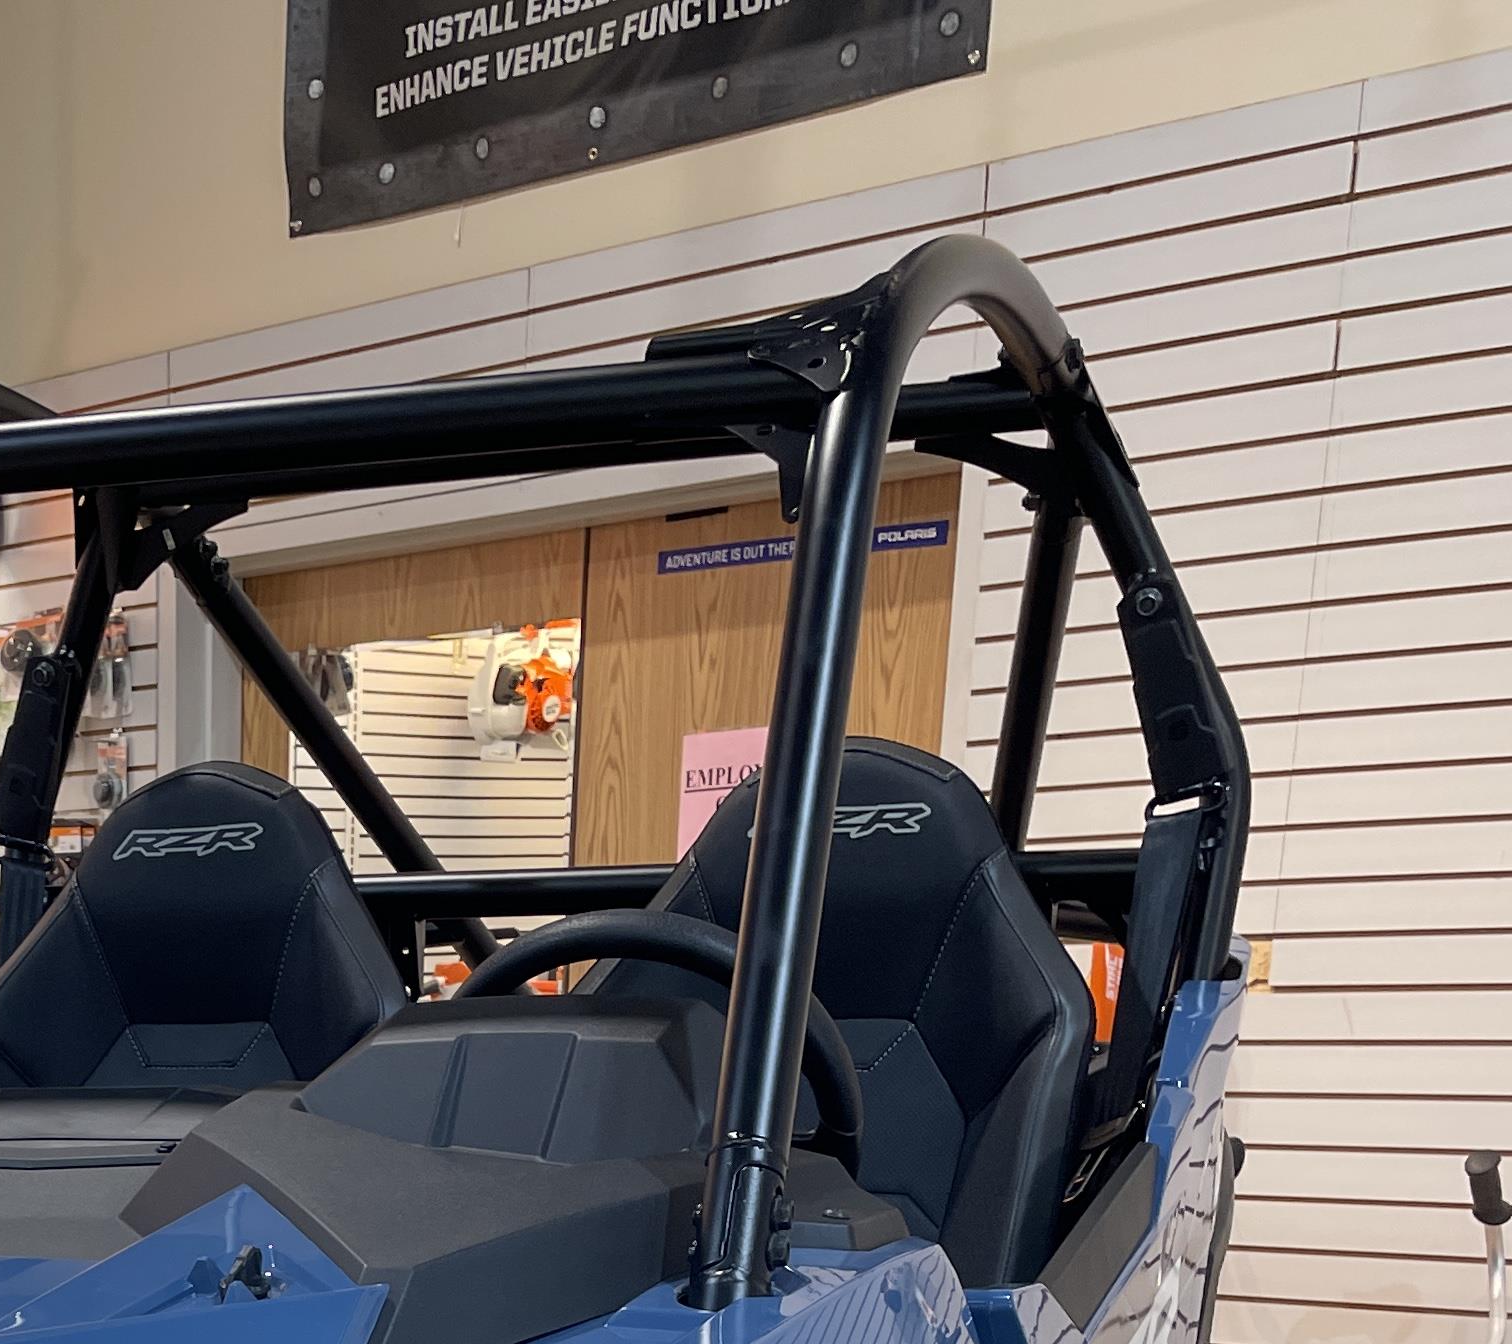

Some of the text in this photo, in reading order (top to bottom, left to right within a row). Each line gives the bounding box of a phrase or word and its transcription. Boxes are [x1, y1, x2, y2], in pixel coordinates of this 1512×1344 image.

[405, 0, 519, 58] INSTALL
[375, 54, 489, 118] ENHANCE
[496, 20, 617, 81] VEHICLE
[877, 526, 937, 543] POLARIS
[665, 549, 728, 569] ADVENTURE
[730, 547, 741, 561] IS
[743, 544, 765, 560] OUT
[112, 822, 264, 861] RZR
